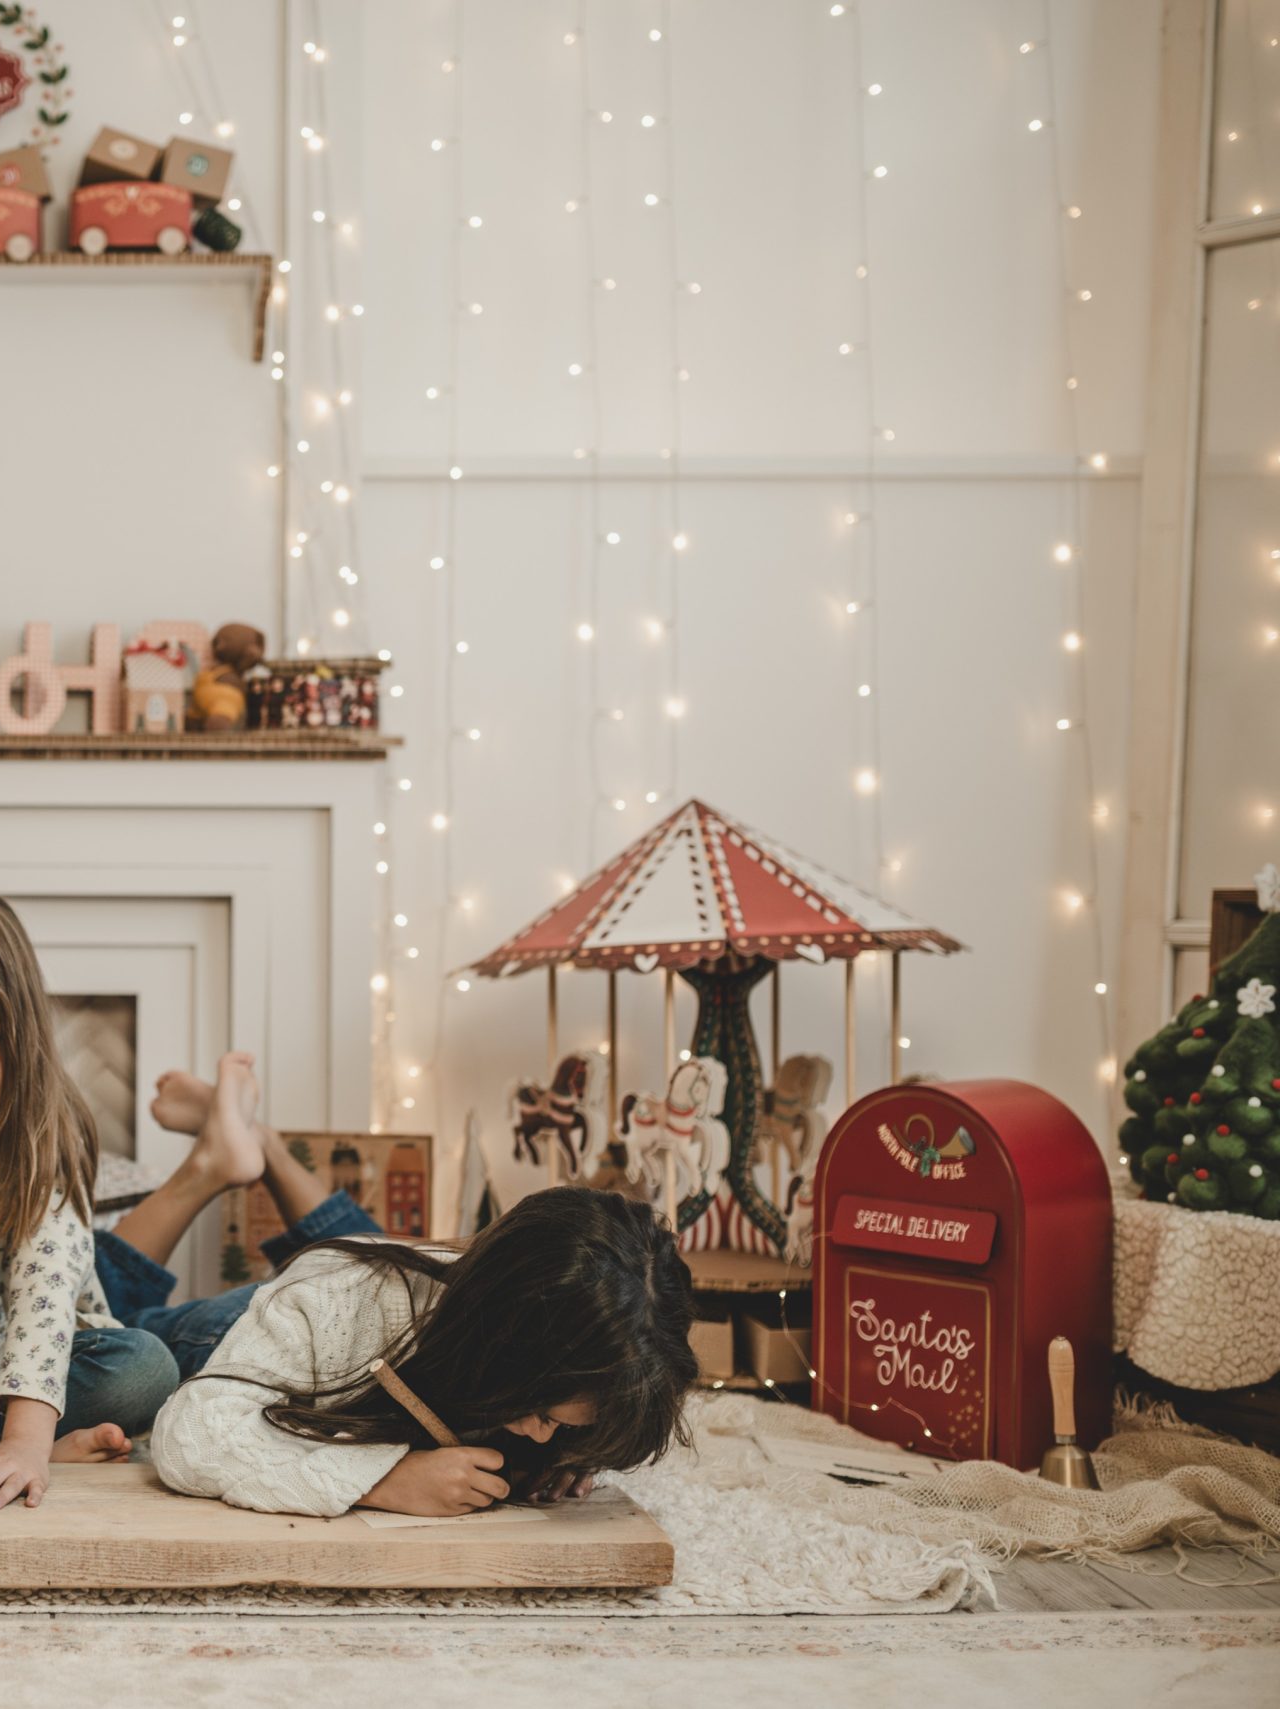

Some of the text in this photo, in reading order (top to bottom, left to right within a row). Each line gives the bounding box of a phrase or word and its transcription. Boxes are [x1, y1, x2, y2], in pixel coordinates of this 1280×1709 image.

[877, 1122, 967, 1180] NORTH POLE OFFICE
[854, 1209, 970, 1243] SPECIAL DELIVERY
[850, 1298, 976, 1360] Santa's
[873, 1343, 959, 1395] Mail
